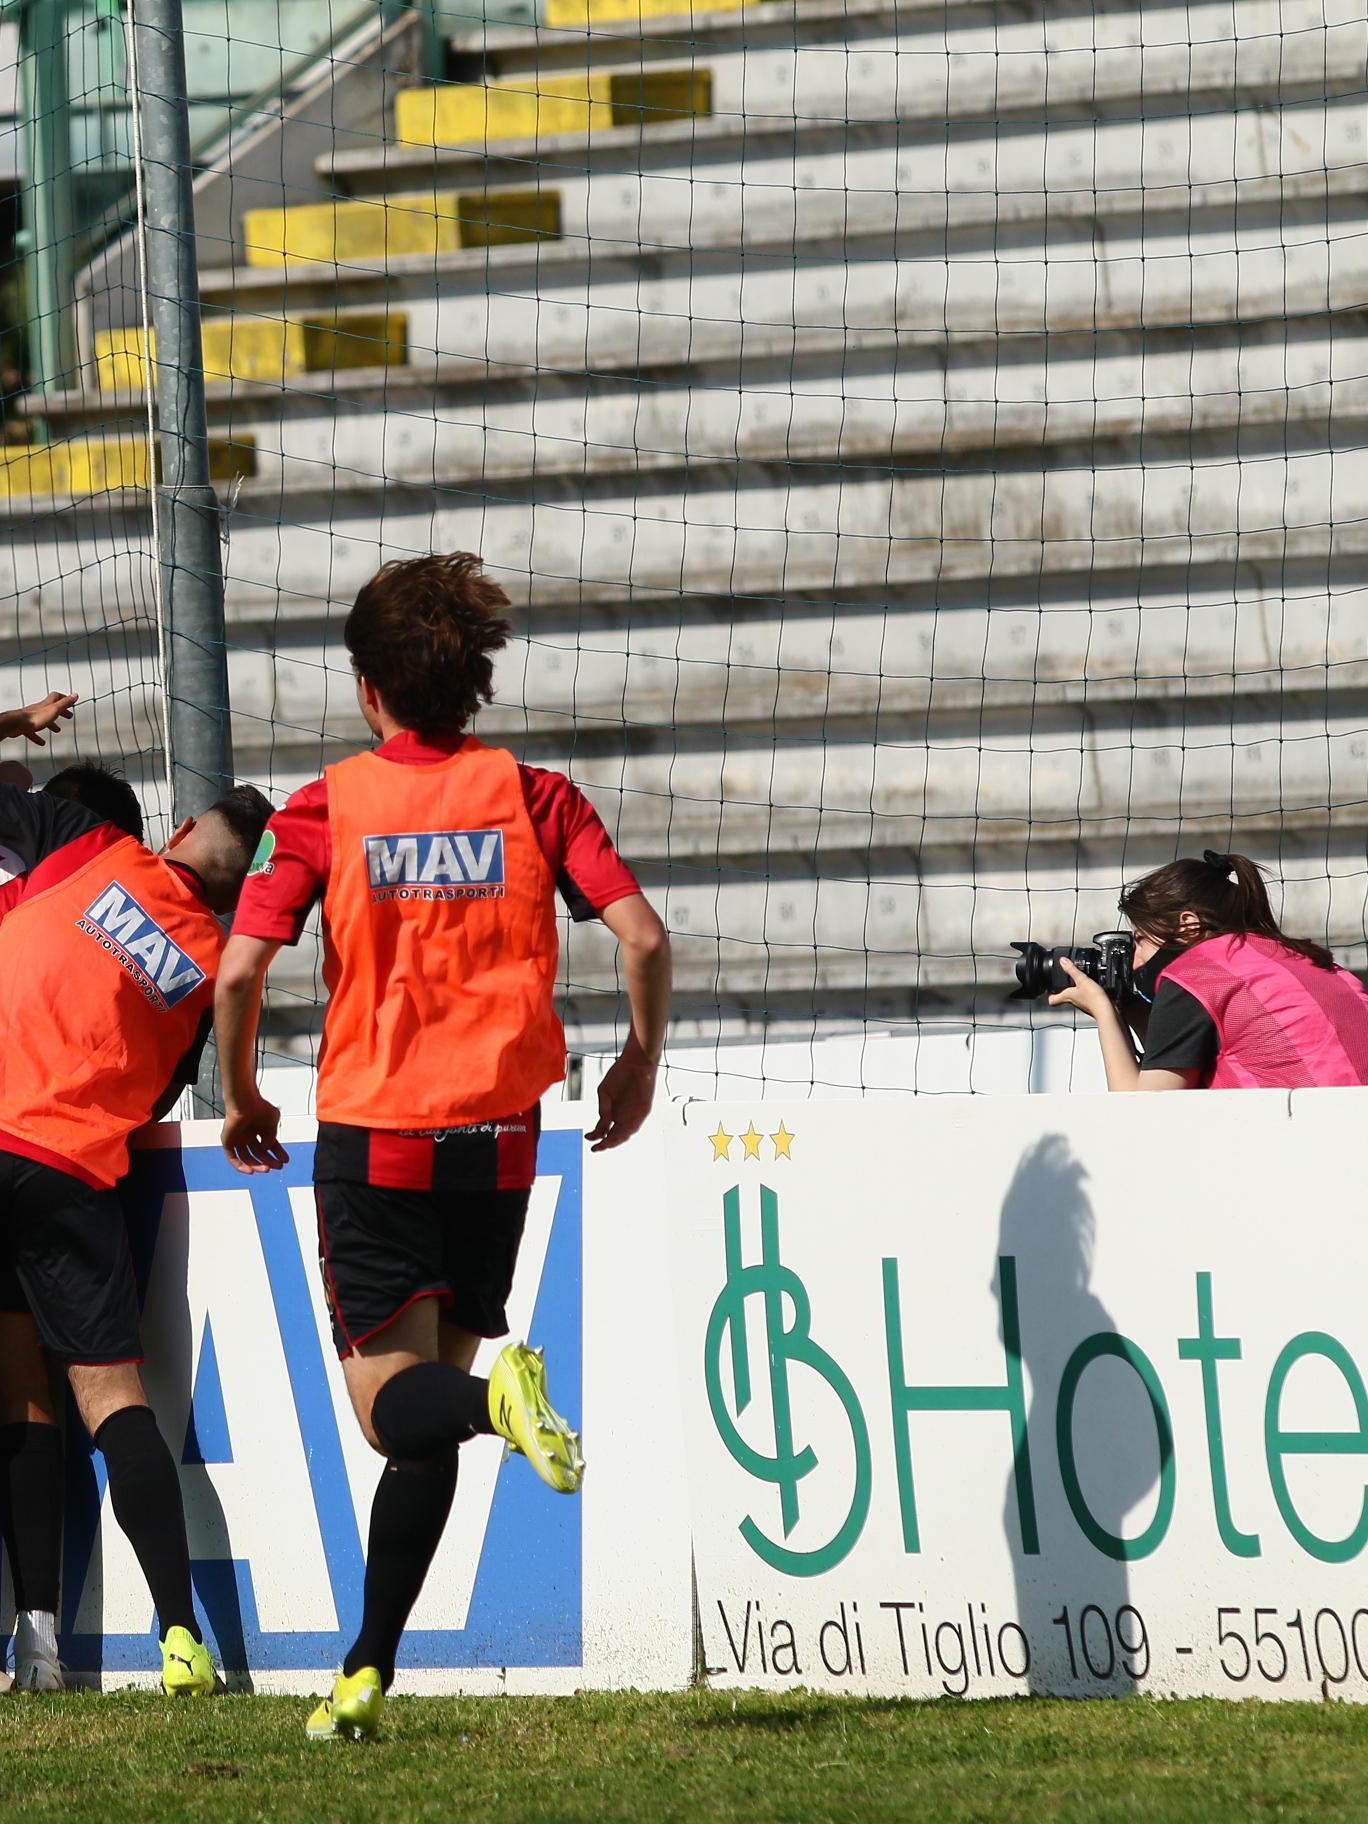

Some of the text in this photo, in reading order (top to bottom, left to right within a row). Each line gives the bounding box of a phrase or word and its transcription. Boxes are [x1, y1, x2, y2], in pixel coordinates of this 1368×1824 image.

[368, 833, 499, 886] MAV
[371, 885, 505, 904] AUTOTRASPORTI
[74, 919, 170, 1013] AUTOTRASPORTI
[88, 885, 202, 994] MAV
[717, 1599, 803, 1675] Via
[819, 1600, 867, 1676] di
[880, 1602, 1032, 1698] Tiglio
[1052, 1603, 1151, 1682] 109
